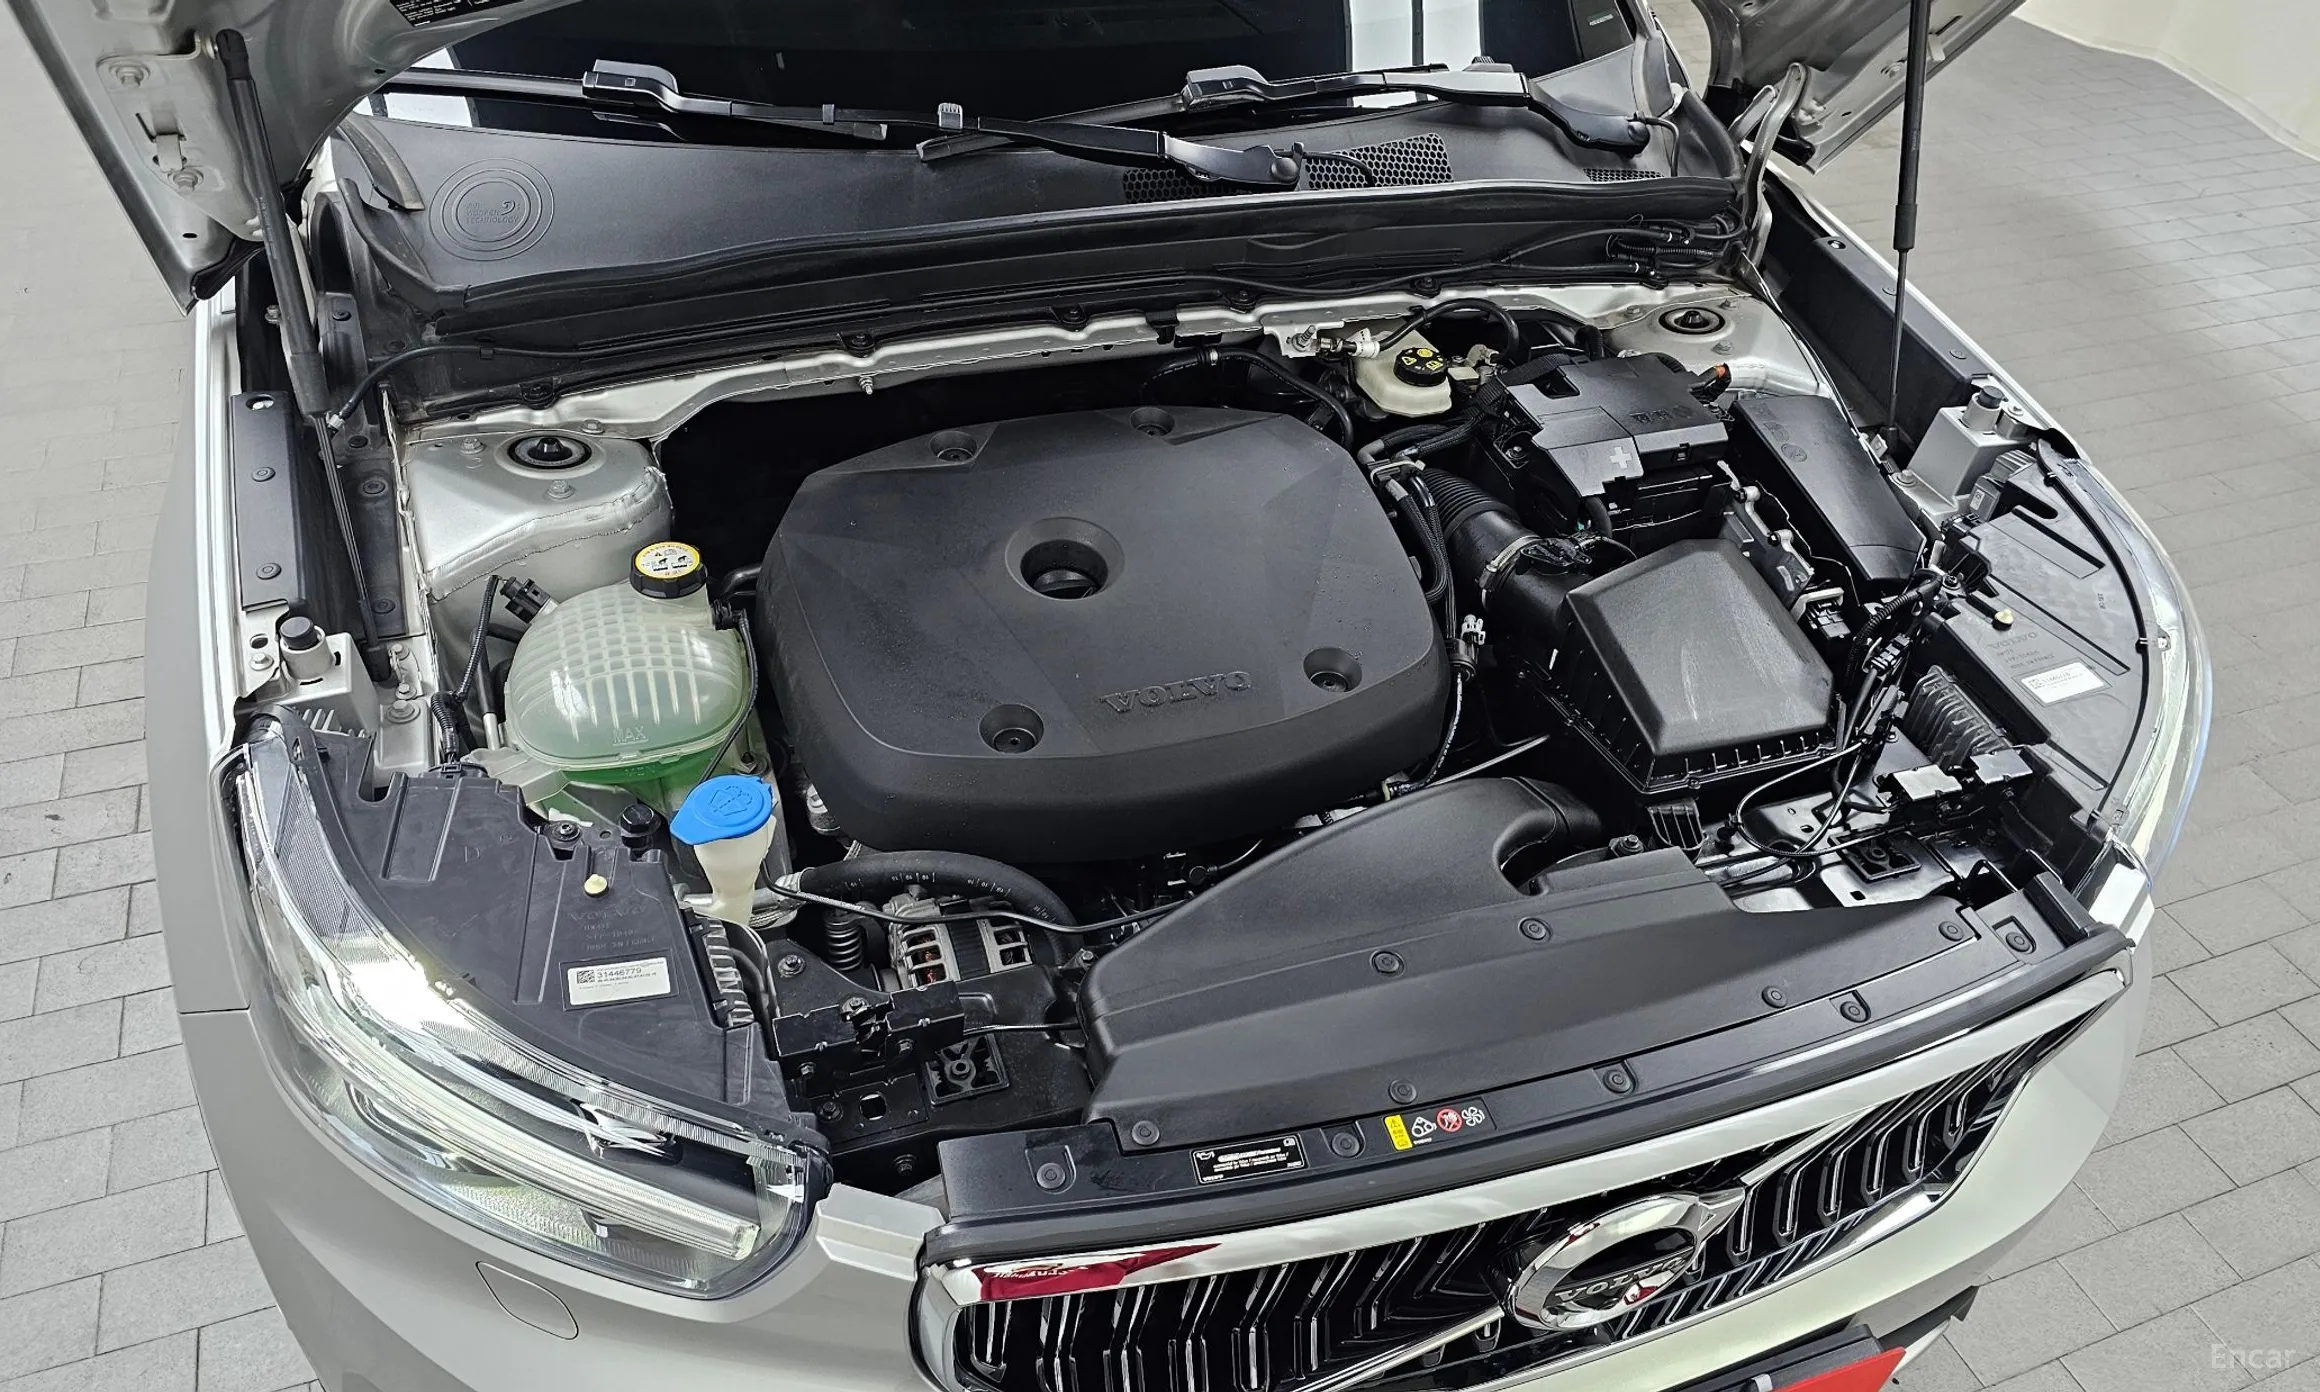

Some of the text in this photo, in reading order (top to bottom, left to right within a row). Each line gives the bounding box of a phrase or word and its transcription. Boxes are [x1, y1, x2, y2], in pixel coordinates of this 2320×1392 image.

[1099, 670, 1253, 713] VOLVO
[613, 724, 647, 744] MAX
[597, 967, 642, 979] 31446779
[1555, 1257, 1687, 1302] VOLVO
